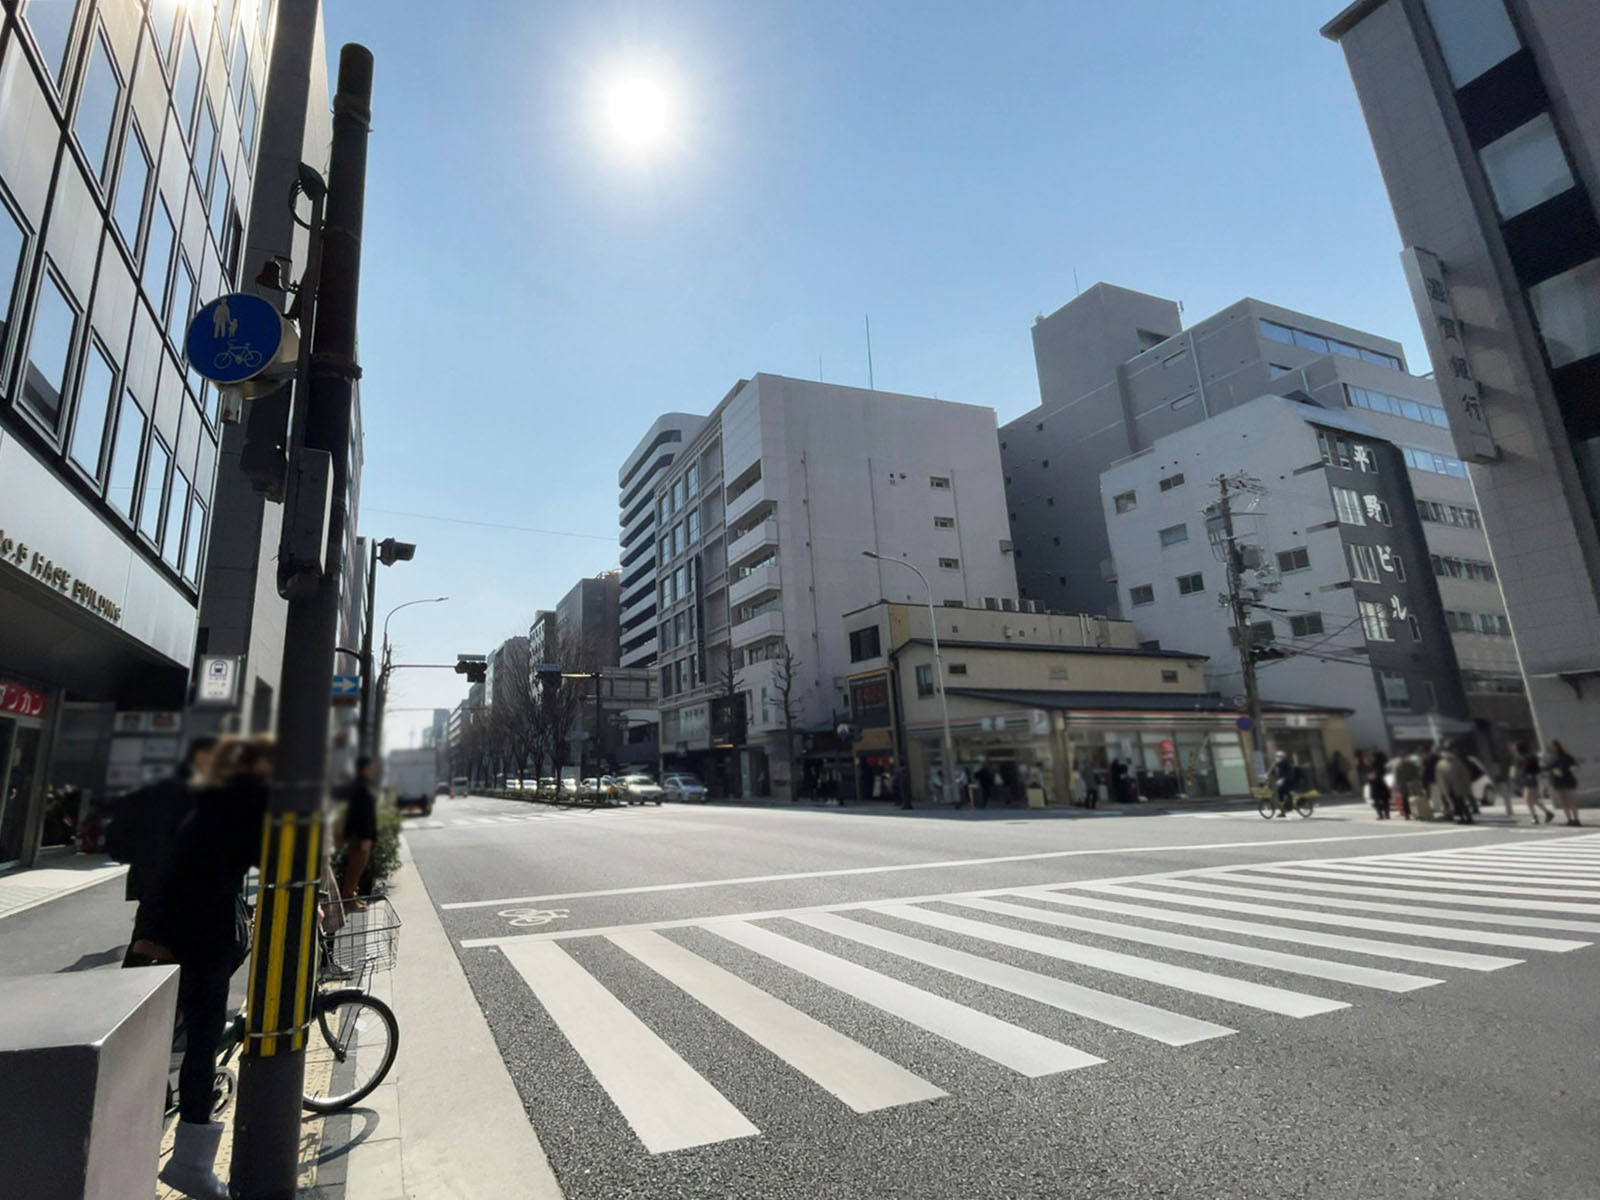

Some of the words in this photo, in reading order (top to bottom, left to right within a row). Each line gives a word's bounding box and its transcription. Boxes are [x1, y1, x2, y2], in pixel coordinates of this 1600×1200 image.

[32, 552, 71, 591] HASE
[72, 579, 122, 621] BUILDING
[1354, 445, 1407, 621] 平野ビル
